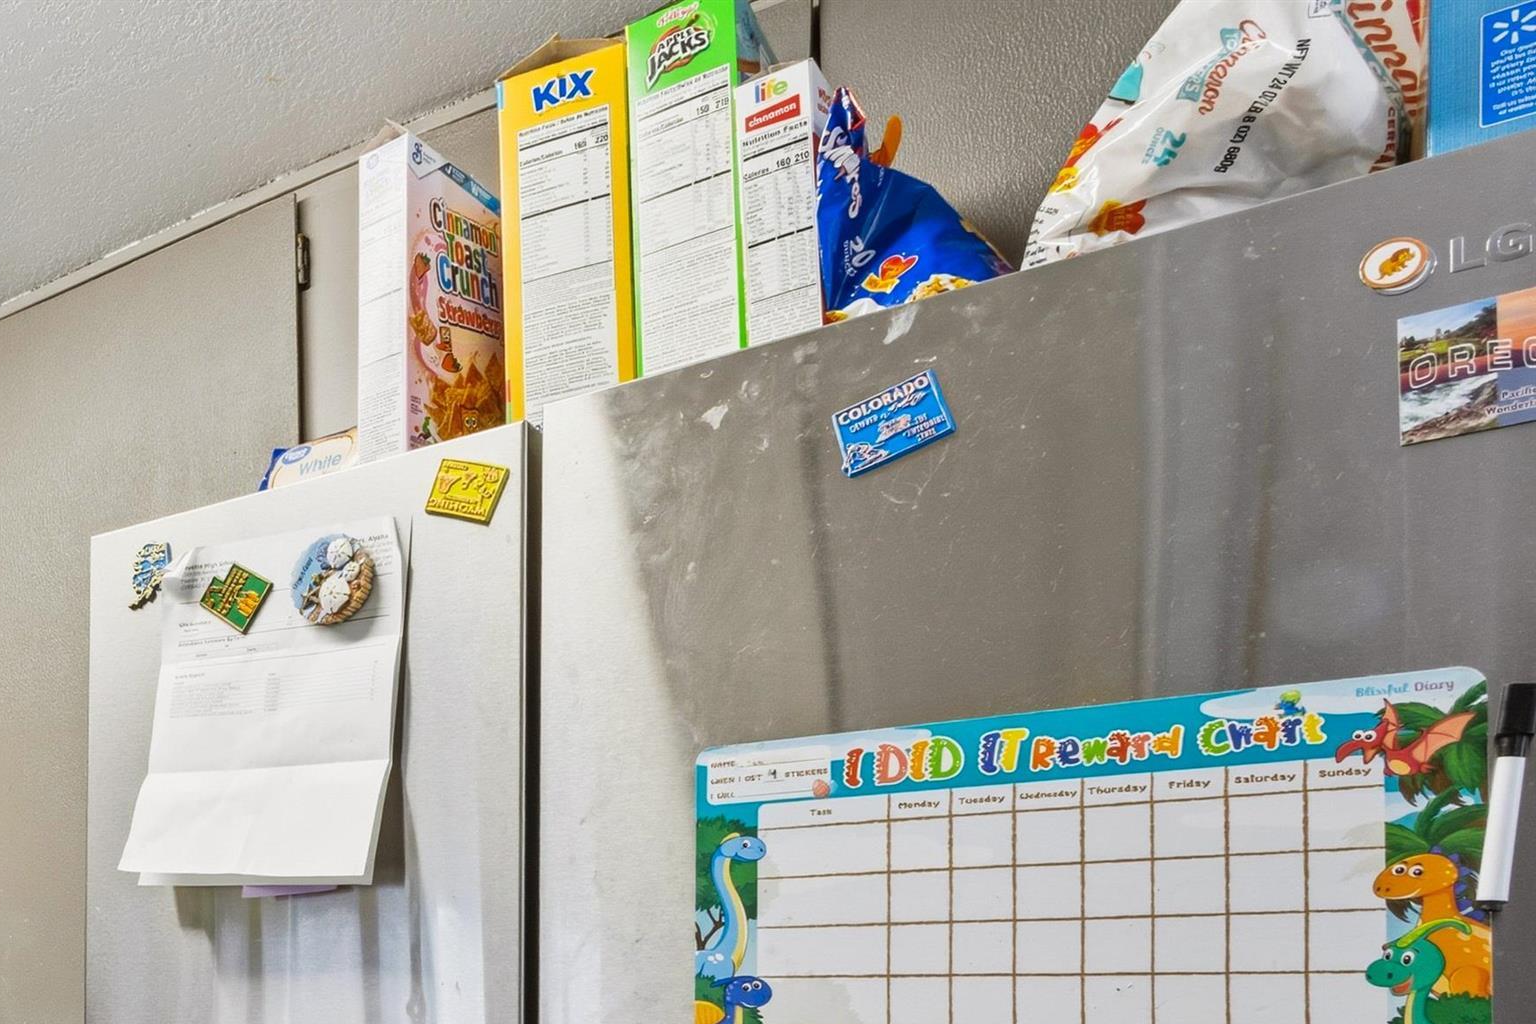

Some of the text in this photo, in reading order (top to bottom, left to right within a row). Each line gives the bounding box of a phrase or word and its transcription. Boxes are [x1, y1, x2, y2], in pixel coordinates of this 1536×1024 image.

[657, 27, 695, 52] APPLE
[647, 31, 708, 83] JACKS
[1278, 62, 1302, 79] WT
[532, 68, 595, 113] KIX
[755, 78, 789, 104] life
[1268, 77, 1287, 90] 24
[748, 102, 797, 128] cinnamon
[1214, 146, 1241, 173] 680g
[430, 197, 499, 256] Cinnamon
[444, 230, 488, 275] Toast
[1449, 222, 1535, 273] LG
[436, 250, 501, 312] Crunch
[838, 375, 929, 426] COLORADO
[299, 453, 342, 477] White
[1355, 680, 1455, 698] Blissful Diary
[874, 736, 965, 786] DID
[979, 727, 1030, 774] IT
[1167, 777, 1212, 790] Friday
[1233, 771, 1297, 785] Saturday
[1318, 765, 1372, 778] Sunday
[958, 794, 1006, 806] Tuesday
[1019, 788, 1078, 801] Wednesday
[1087, 782, 1148, 795] Thursday
[898, 799, 941, 810] Monday
